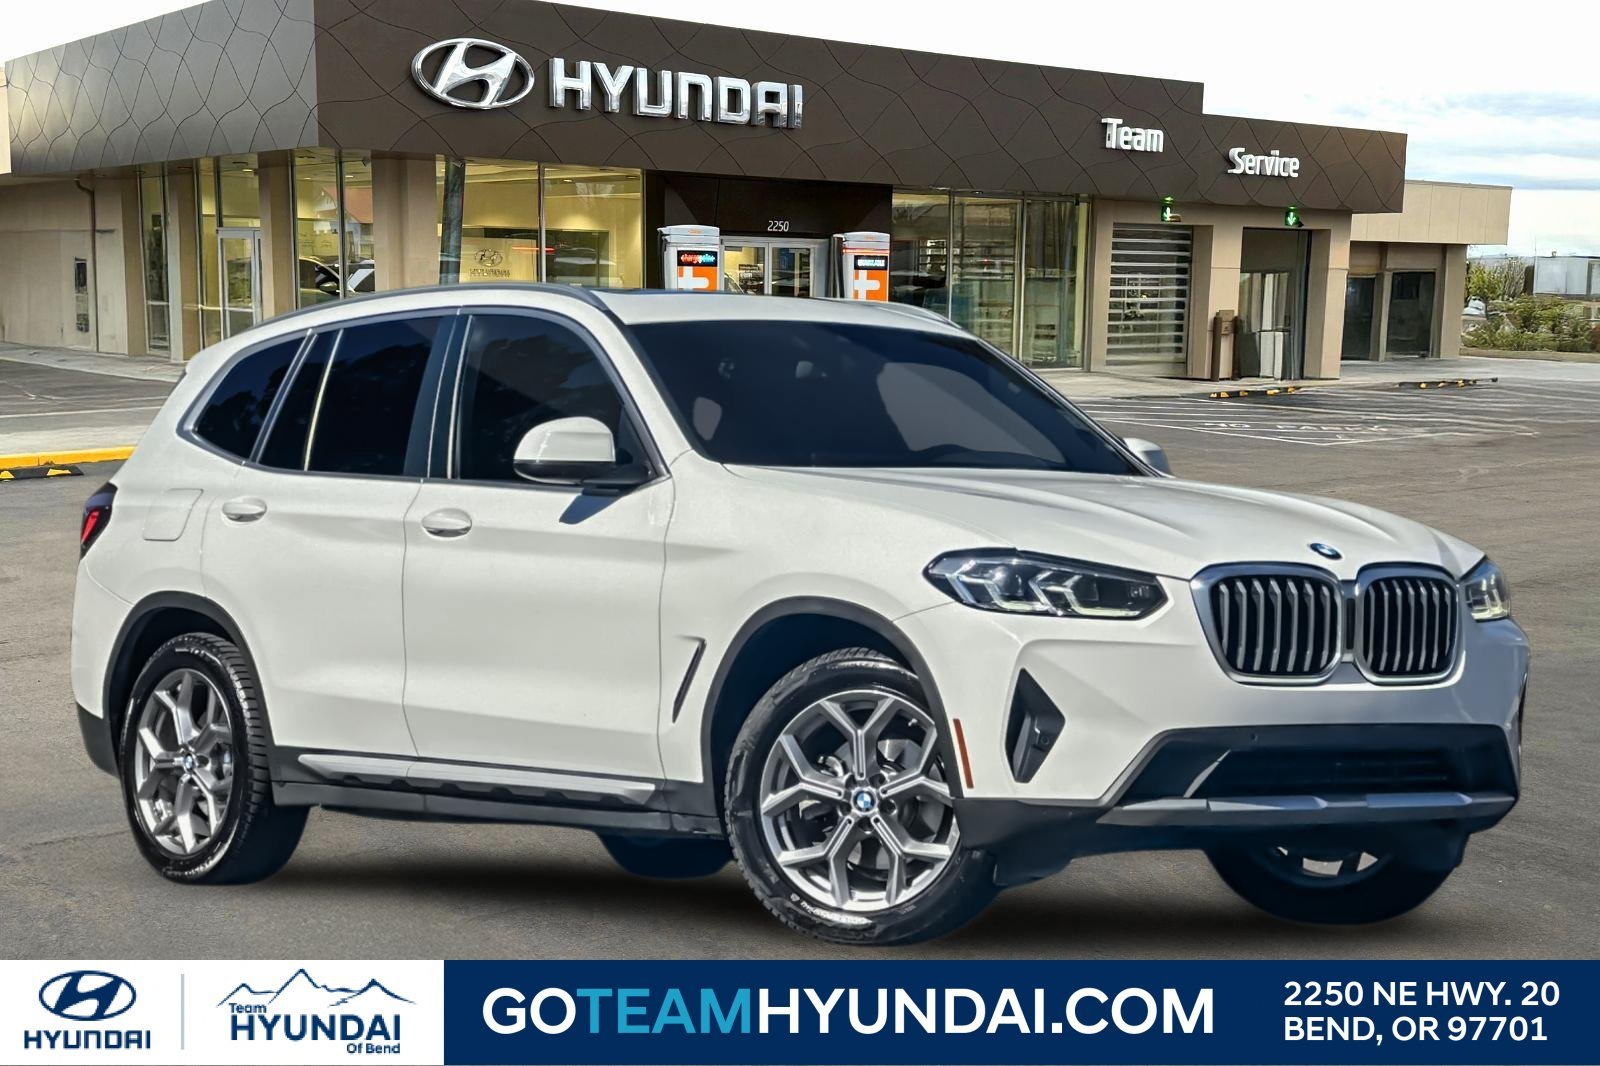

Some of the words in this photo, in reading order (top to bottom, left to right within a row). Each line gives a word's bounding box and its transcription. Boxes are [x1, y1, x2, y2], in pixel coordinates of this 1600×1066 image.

[549, 57, 803, 129] HYUNDAI
[1101, 117, 1164, 152] Team
[1227, 147, 1300, 177] Service
[767, 220, 790, 232] 2250
